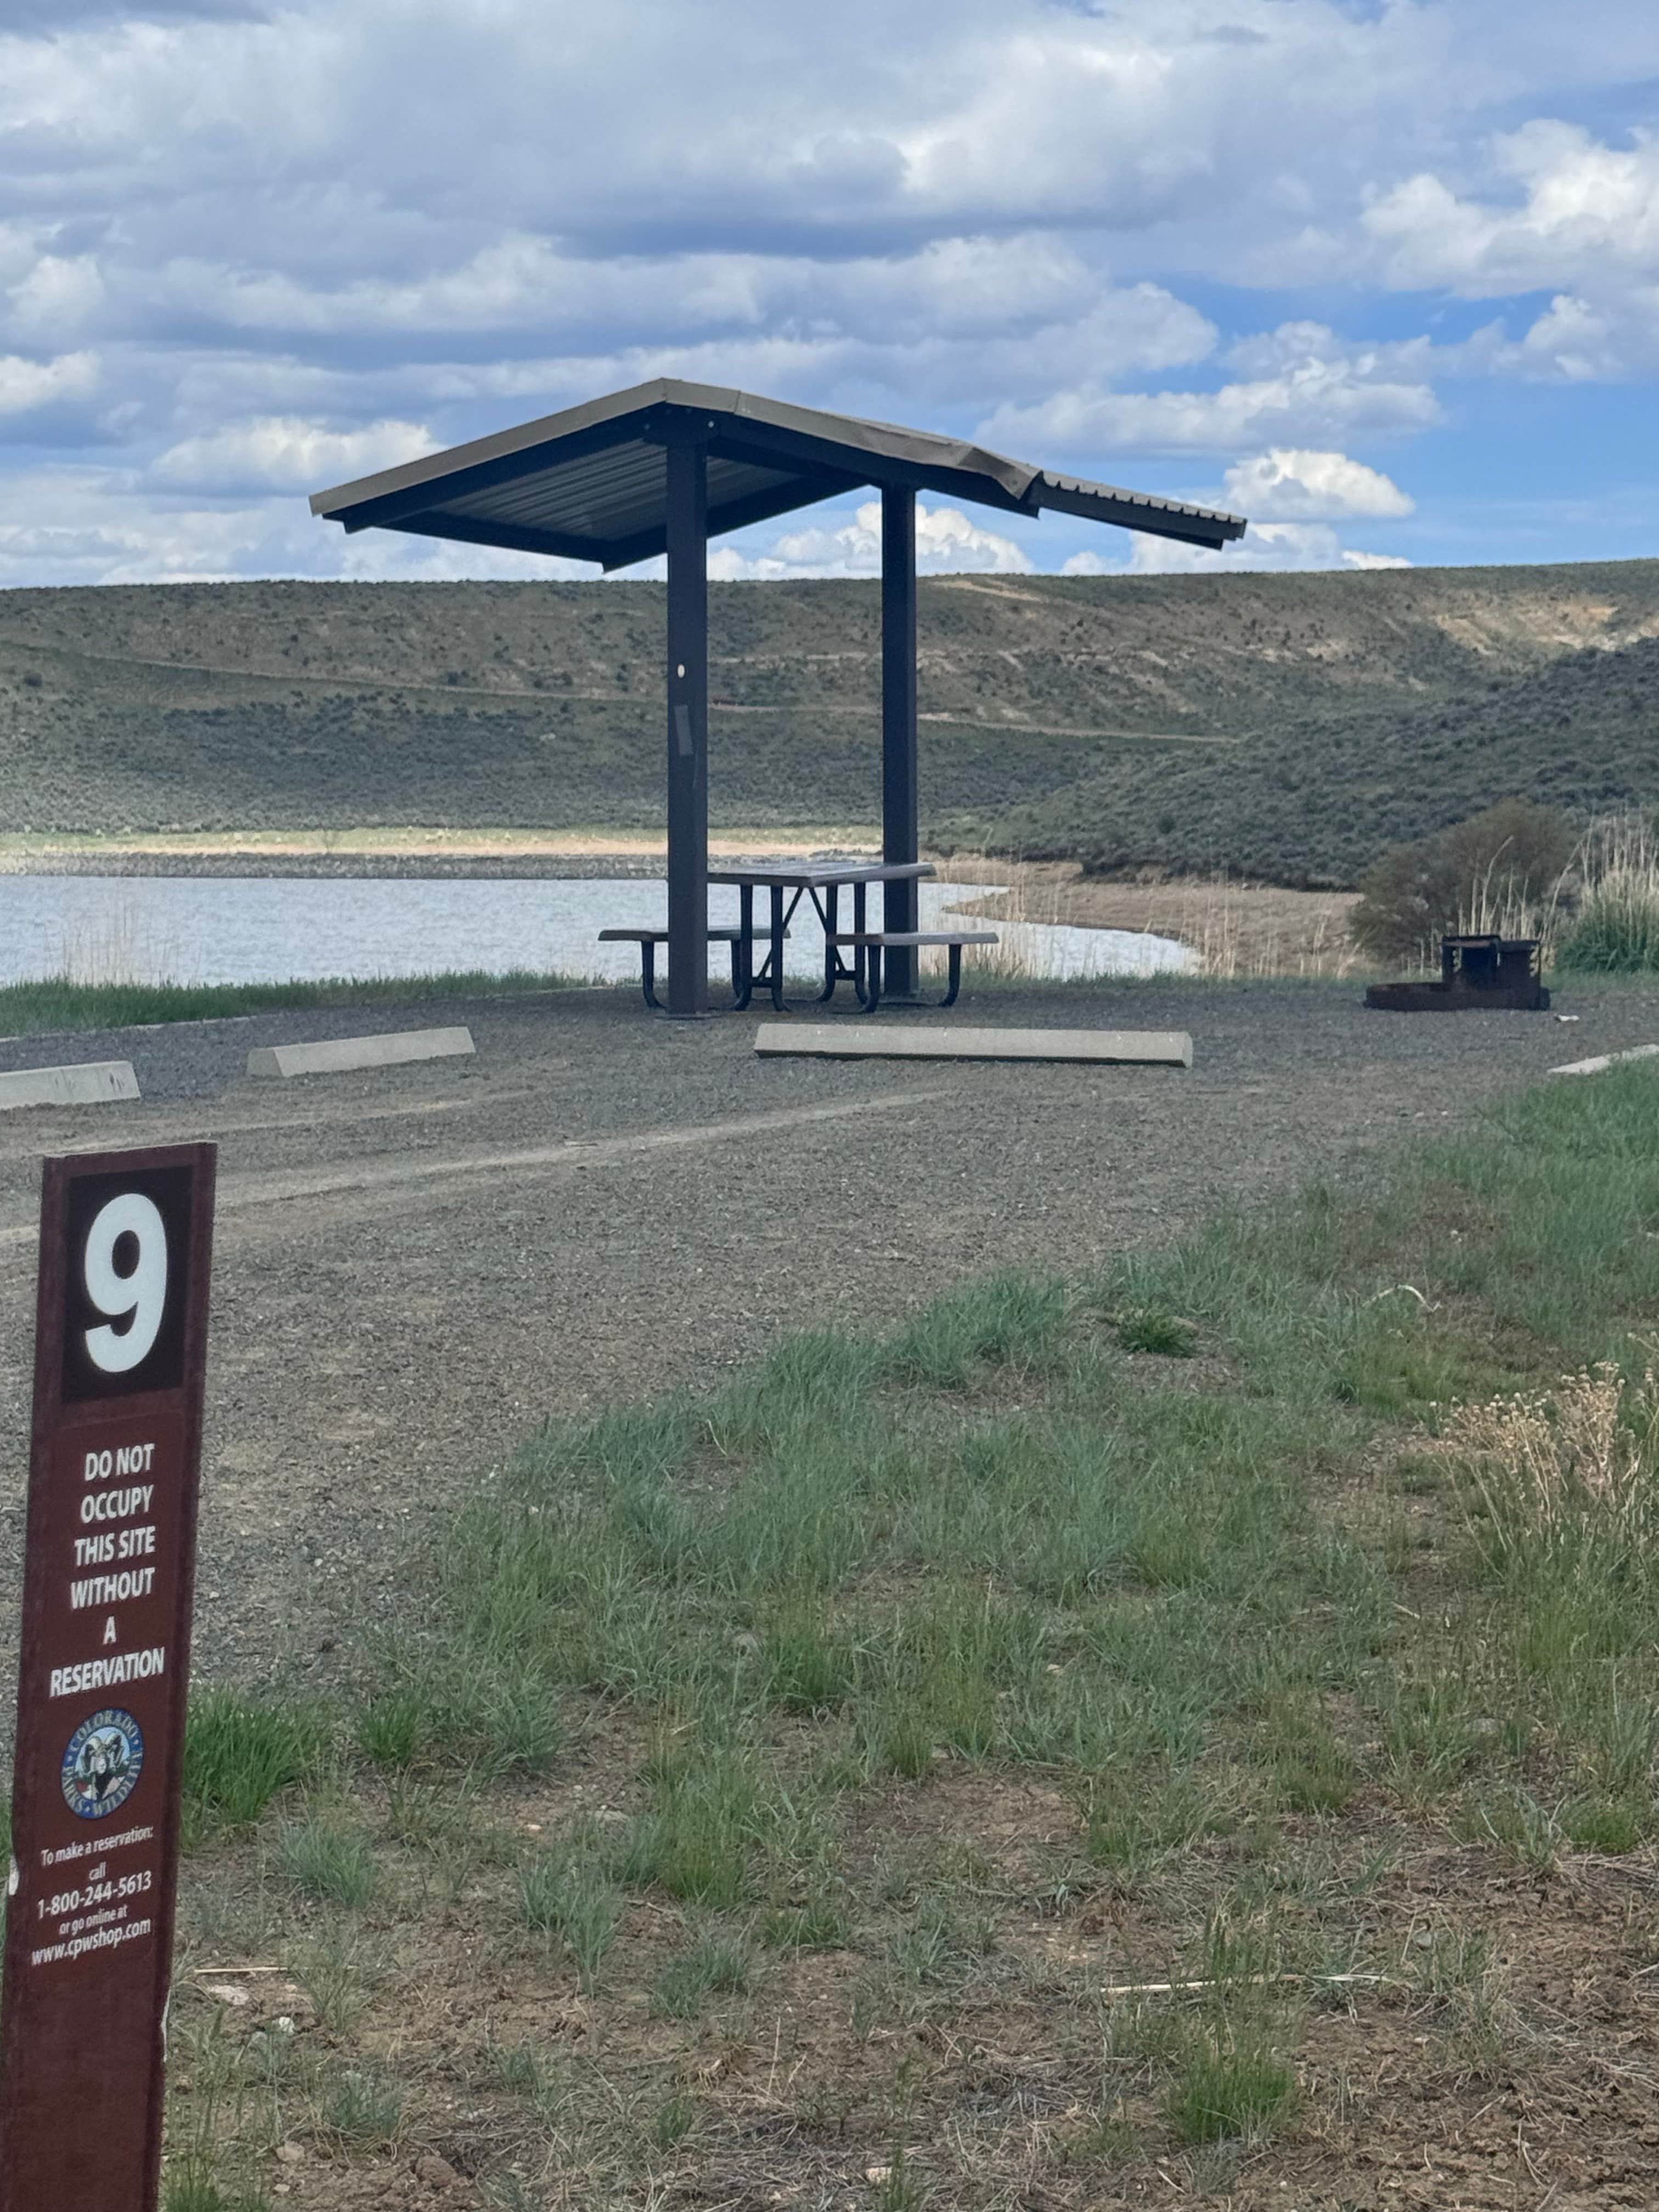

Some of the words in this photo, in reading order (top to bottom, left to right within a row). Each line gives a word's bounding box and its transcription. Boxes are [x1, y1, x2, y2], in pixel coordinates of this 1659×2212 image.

[84, 1193, 167, 1373] 9
[84, 1450, 112, 1481] DO
[116, 1442, 155, 1476] NOT
[81, 1484, 154, 1524] OCCUPY
[74, 1532, 114, 1567] THIS
[117, 1526, 156, 1559] SITE
[70, 1567, 155, 1610] WITHOUT
[103, 1616, 117, 1645] A
[49, 1646, 165, 1698] RESERVATION
[41, 1849, 54, 1866] To
[55, 1841, 84, 1864] make
[84, 1843, 92, 1854] a
[93, 1825, 154, 1853] reservation:
[88, 1861, 106, 1881] call
[37, 1870, 152, 1920] 1-800-244-5613
[59, 1922, 71, 1935] or
[72, 1917, 84, 1936] go
[86, 1908, 117, 1926] online
[117, 1904, 128, 1918] at
[31, 1918, 151, 1967] www.cpwshop.com
